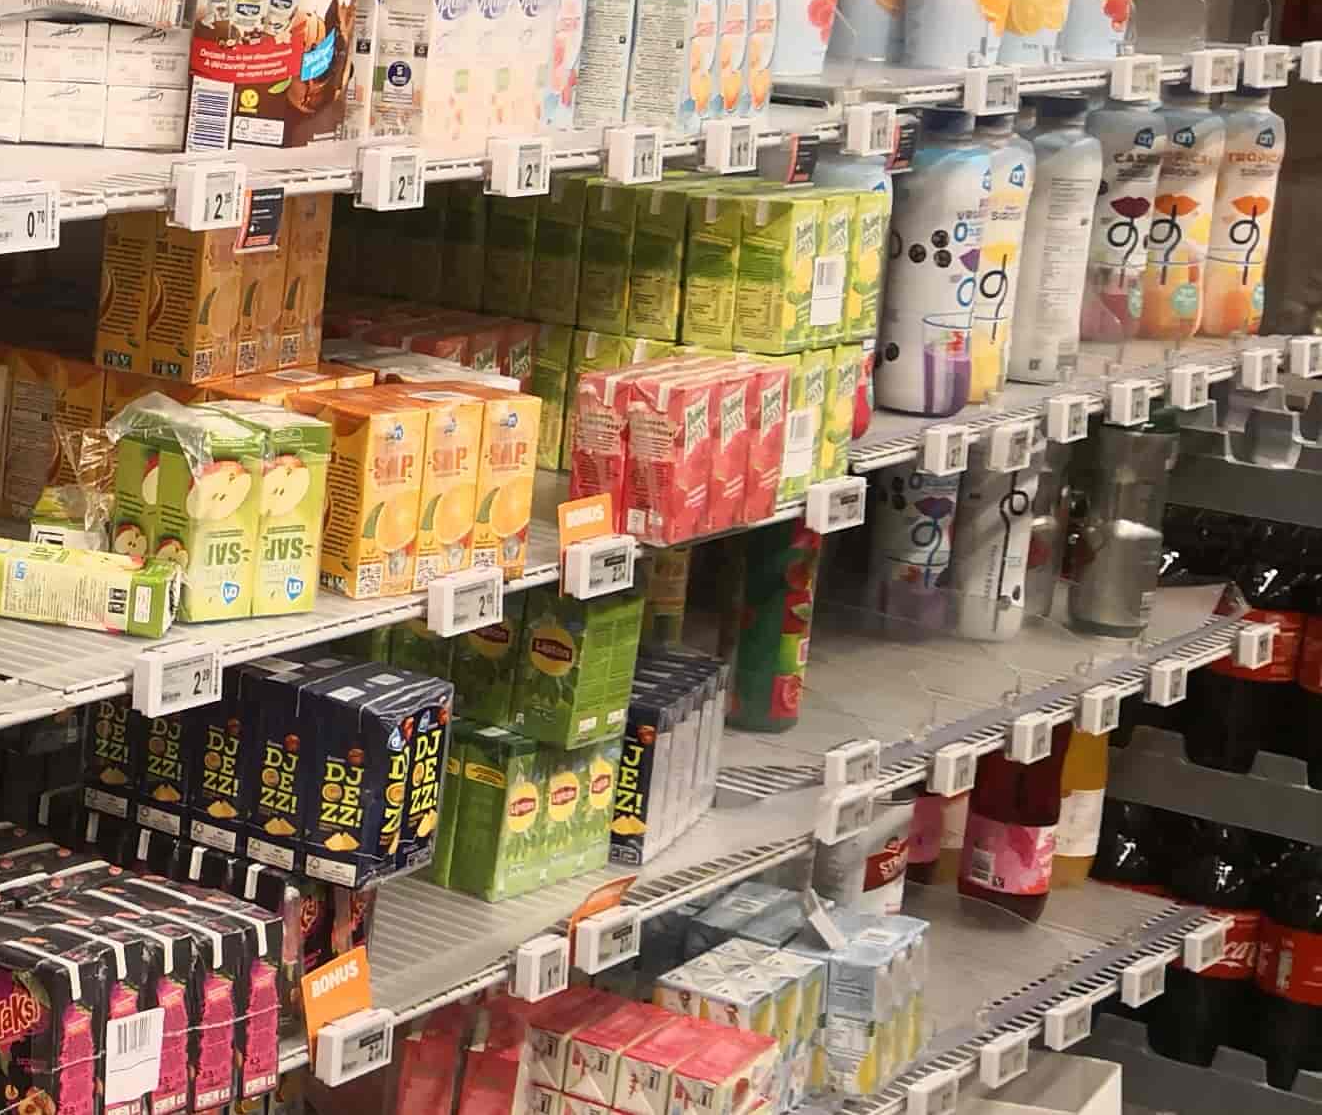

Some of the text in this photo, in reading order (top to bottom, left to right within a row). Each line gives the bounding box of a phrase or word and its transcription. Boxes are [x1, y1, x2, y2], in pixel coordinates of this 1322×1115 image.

[414, 730, 442, 754] DJ
[263, 746, 299, 772] DJ
[325, 761, 365, 786] DJ
[259, 787, 298, 815] ZZ!
[409, 781, 439, 816] ZZ!
[320, 803, 363, 829] ZZ!
[311, 962, 359, 999] BONUS
